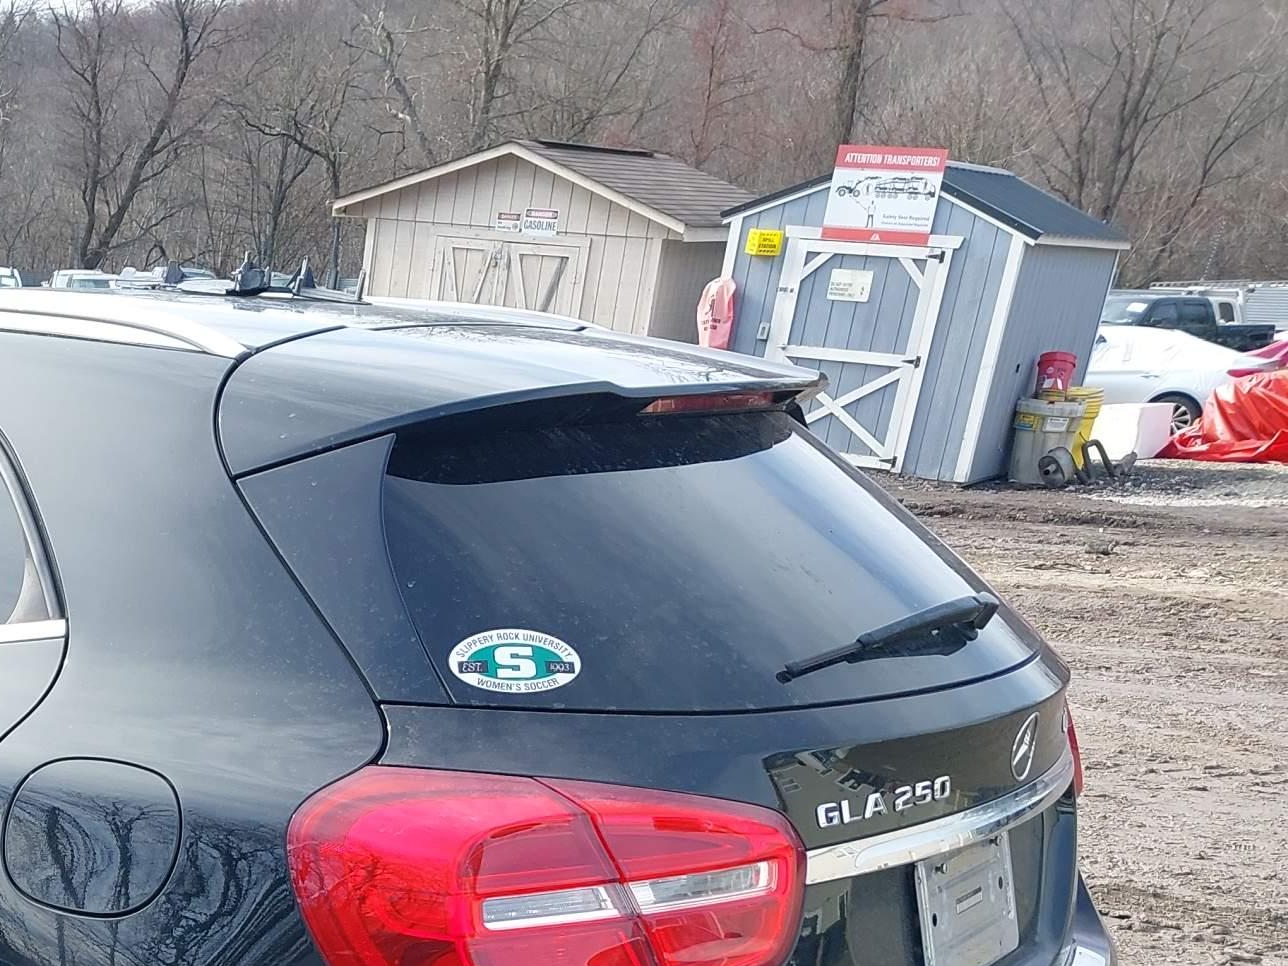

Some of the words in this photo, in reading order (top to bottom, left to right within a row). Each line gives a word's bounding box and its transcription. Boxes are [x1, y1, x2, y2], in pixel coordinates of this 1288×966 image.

[844, 152, 882, 165] ATTENTION
[883, 153, 941, 168] TRANSPORTERS!
[523, 219, 558, 232] GASOLINE
[455, 634, 494, 658] SLIPPERY
[496, 632, 521, 641] ROCK
[522, 633, 573, 659] UNIVERSITY
[461, 662, 483, 673] EST.
[493, 645, 537, 680] S
[549, 662, 570, 672] 1993
[476, 677, 522, 692] WOMEN'S
[524, 677, 560, 691] SOCCER
[816, 792, 889, 829] GLA
[894, 775, 951, 813] 250
